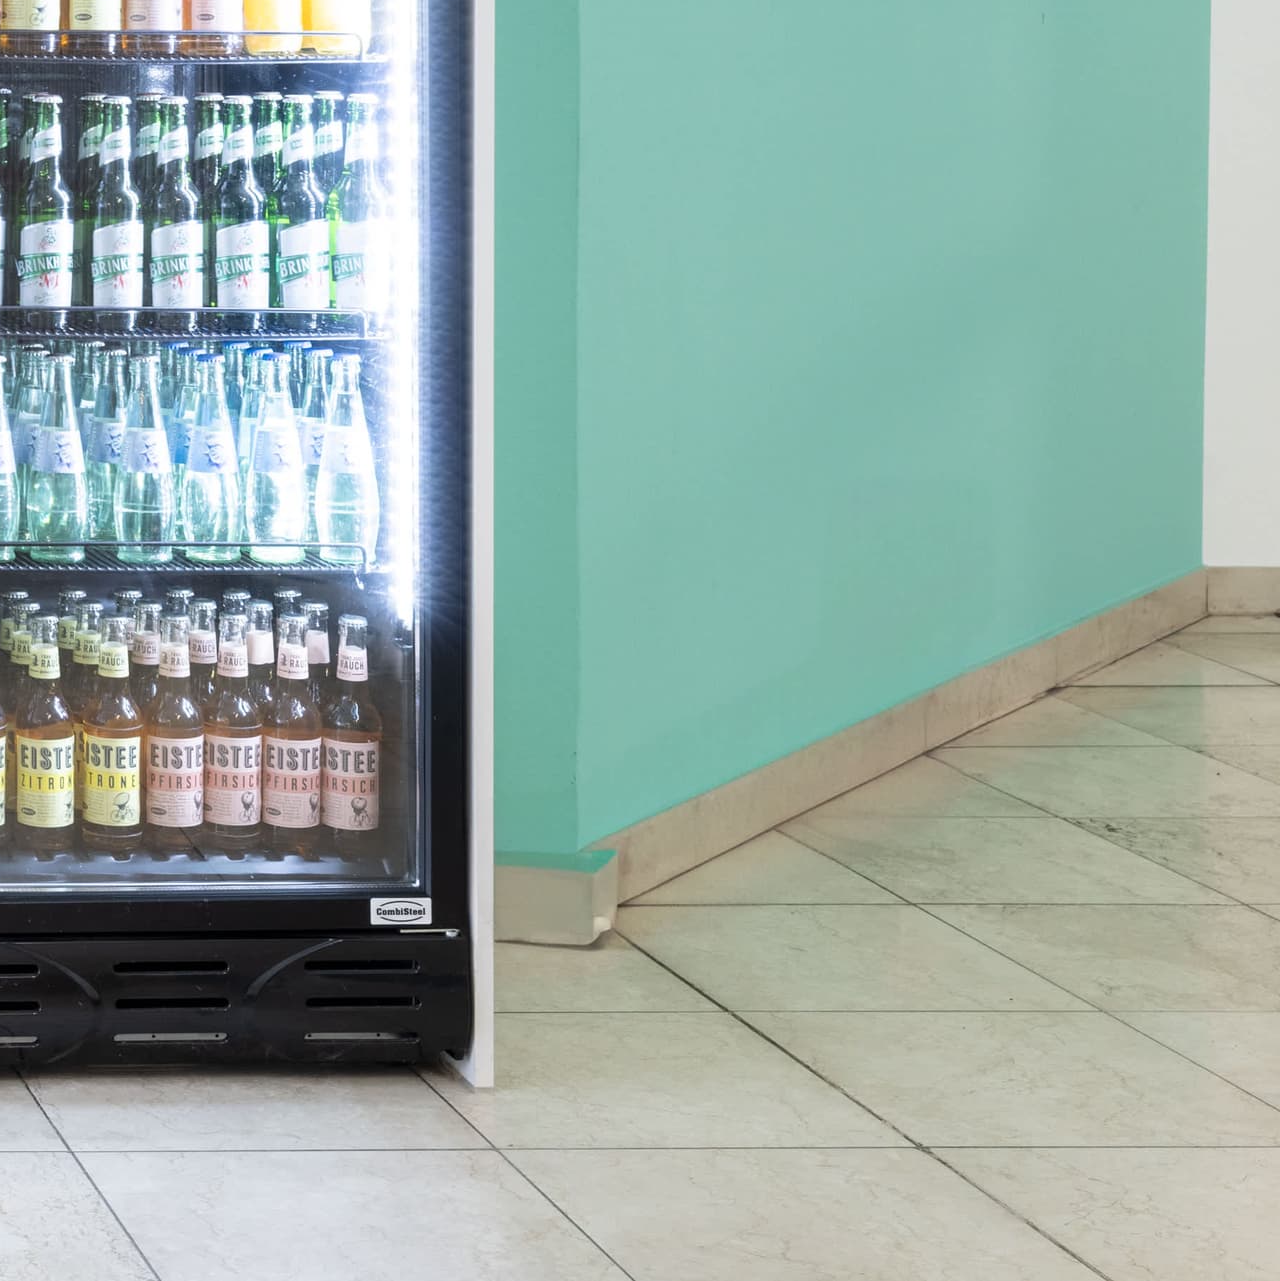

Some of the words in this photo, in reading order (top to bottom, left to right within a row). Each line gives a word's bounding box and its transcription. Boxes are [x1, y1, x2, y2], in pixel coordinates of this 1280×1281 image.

[20, 743, 73, 769] EISTE
[150, 743, 202, 770] EISTE
[266, 743, 320, 771] EISTE
[89, 771, 137, 789] TRONE
[325, 775, 376, 794] IRSICH
[376, 907, 426, 916] CombiSteel
